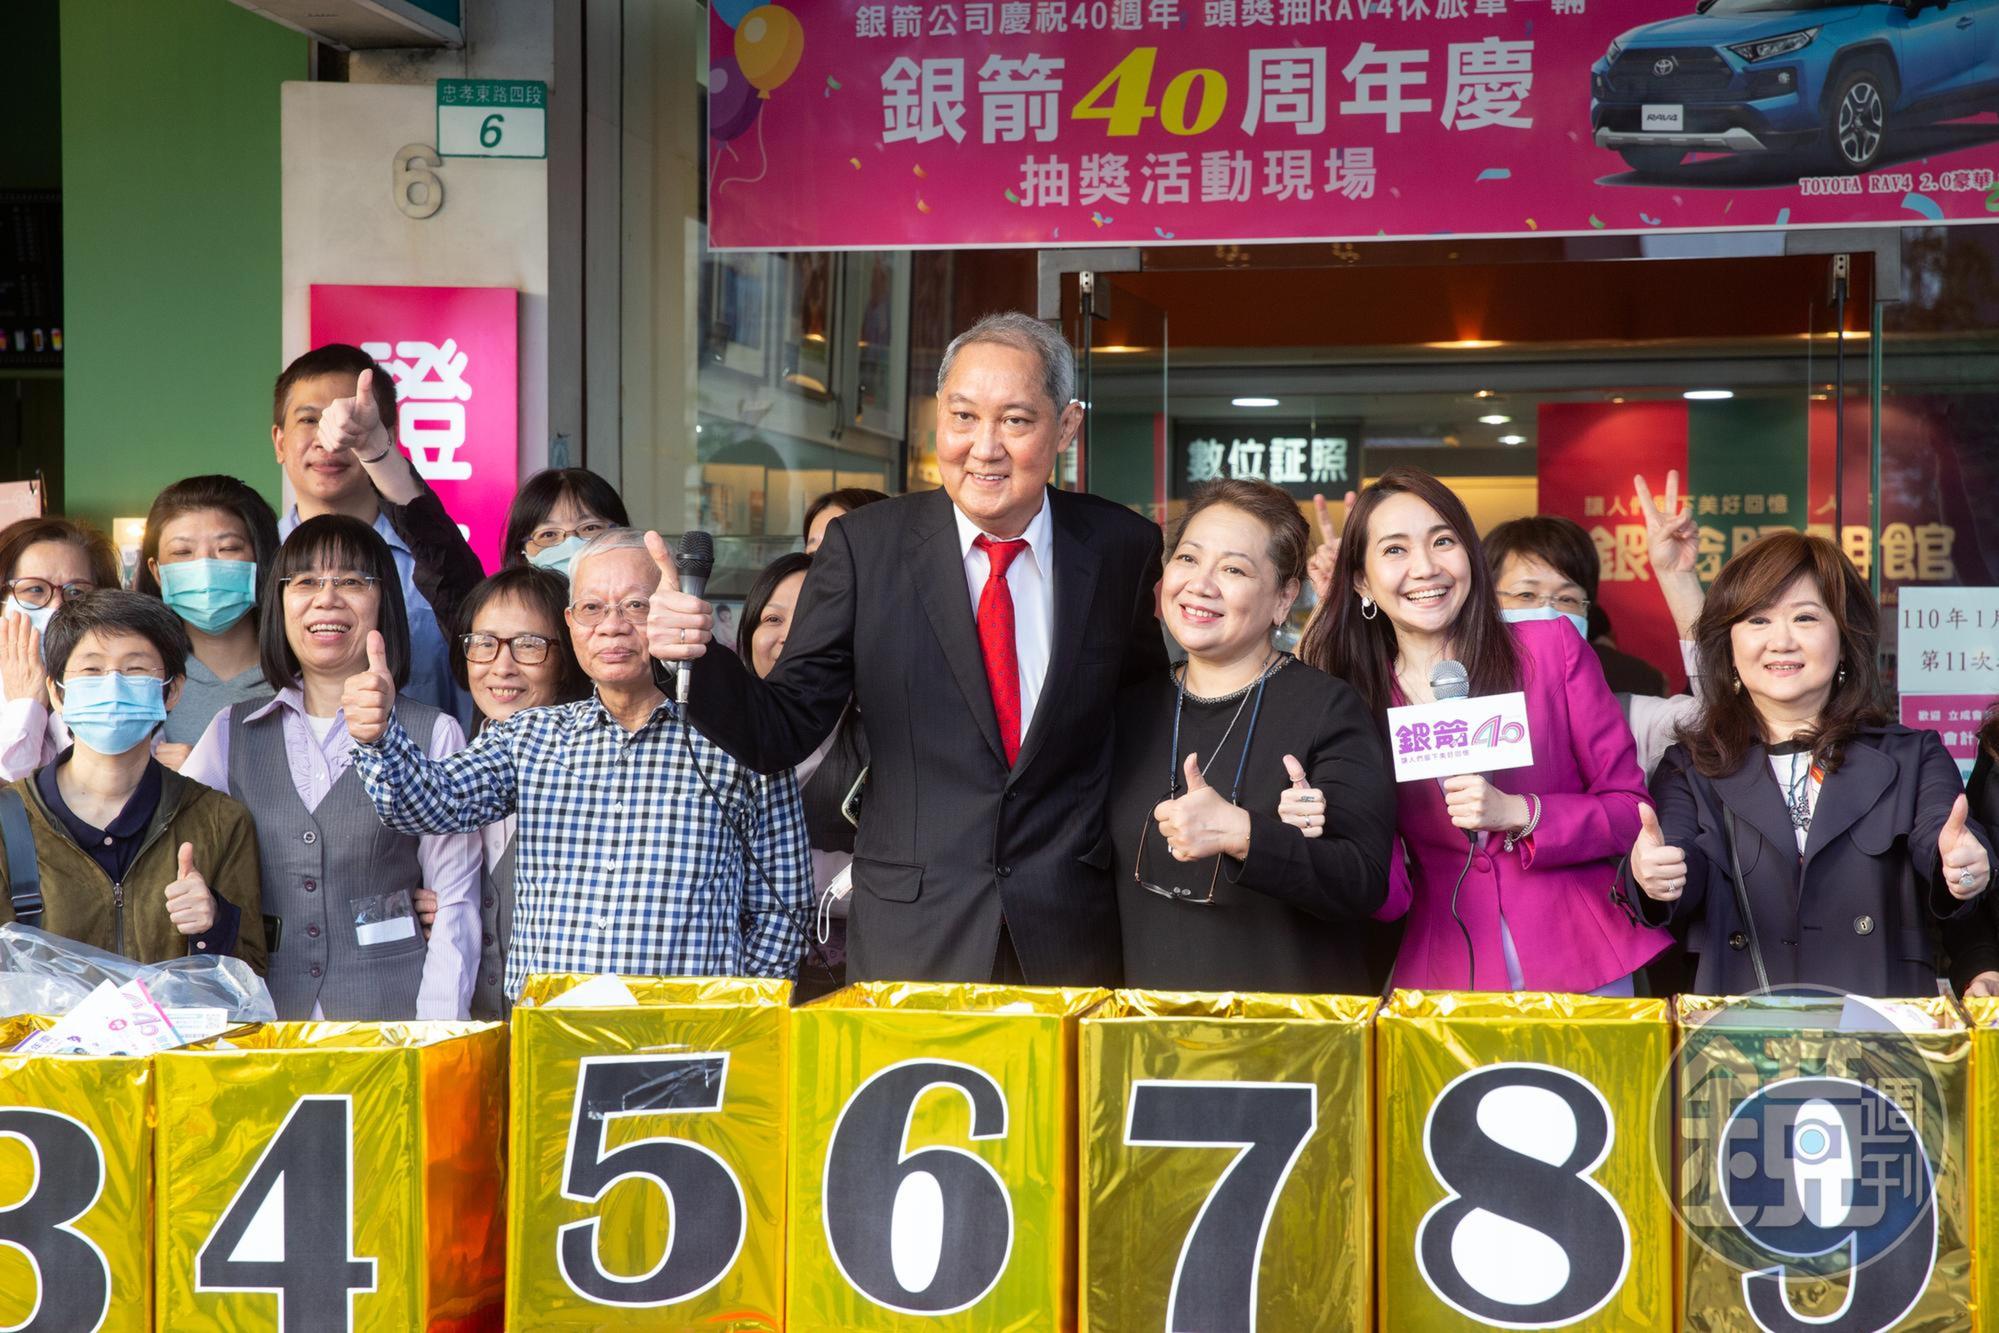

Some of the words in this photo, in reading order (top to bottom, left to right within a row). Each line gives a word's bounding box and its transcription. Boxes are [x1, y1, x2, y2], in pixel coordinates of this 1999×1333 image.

[855, 0, 1181, 38] 銀箭公司慶祝40週年
[442, 84, 542, 104] 忠孝東路四段
[880, 36, 1535, 144] 銀箭40周年慶
[1646, 113, 1679, 122] RAV4
[479, 113, 504, 148] 6
[392, 143, 443, 220] 6
[1019, 148, 1377, 207] 抽獎活動現場
[1800, 176, 1862, 194] TOYOTA
[1869, 174, 1913, 193] RAV4
[1187, 437, 1348, 483] 數位証照
[1920, 650, 1999, 672] 第11次
[1396, 719, 1468, 755] 銀箭
[195, 1094, 378, 1333] 4
[556, 1052, 747, 1309] 5
[822, 1058, 1014, 1315] 6
[1124, 1079, 1317, 1333] 7
[1415, 1062, 1632, 1330] 8
[1718, 1075, 1939, 1333] 9
[0, 1106, 112, 1333] 3
